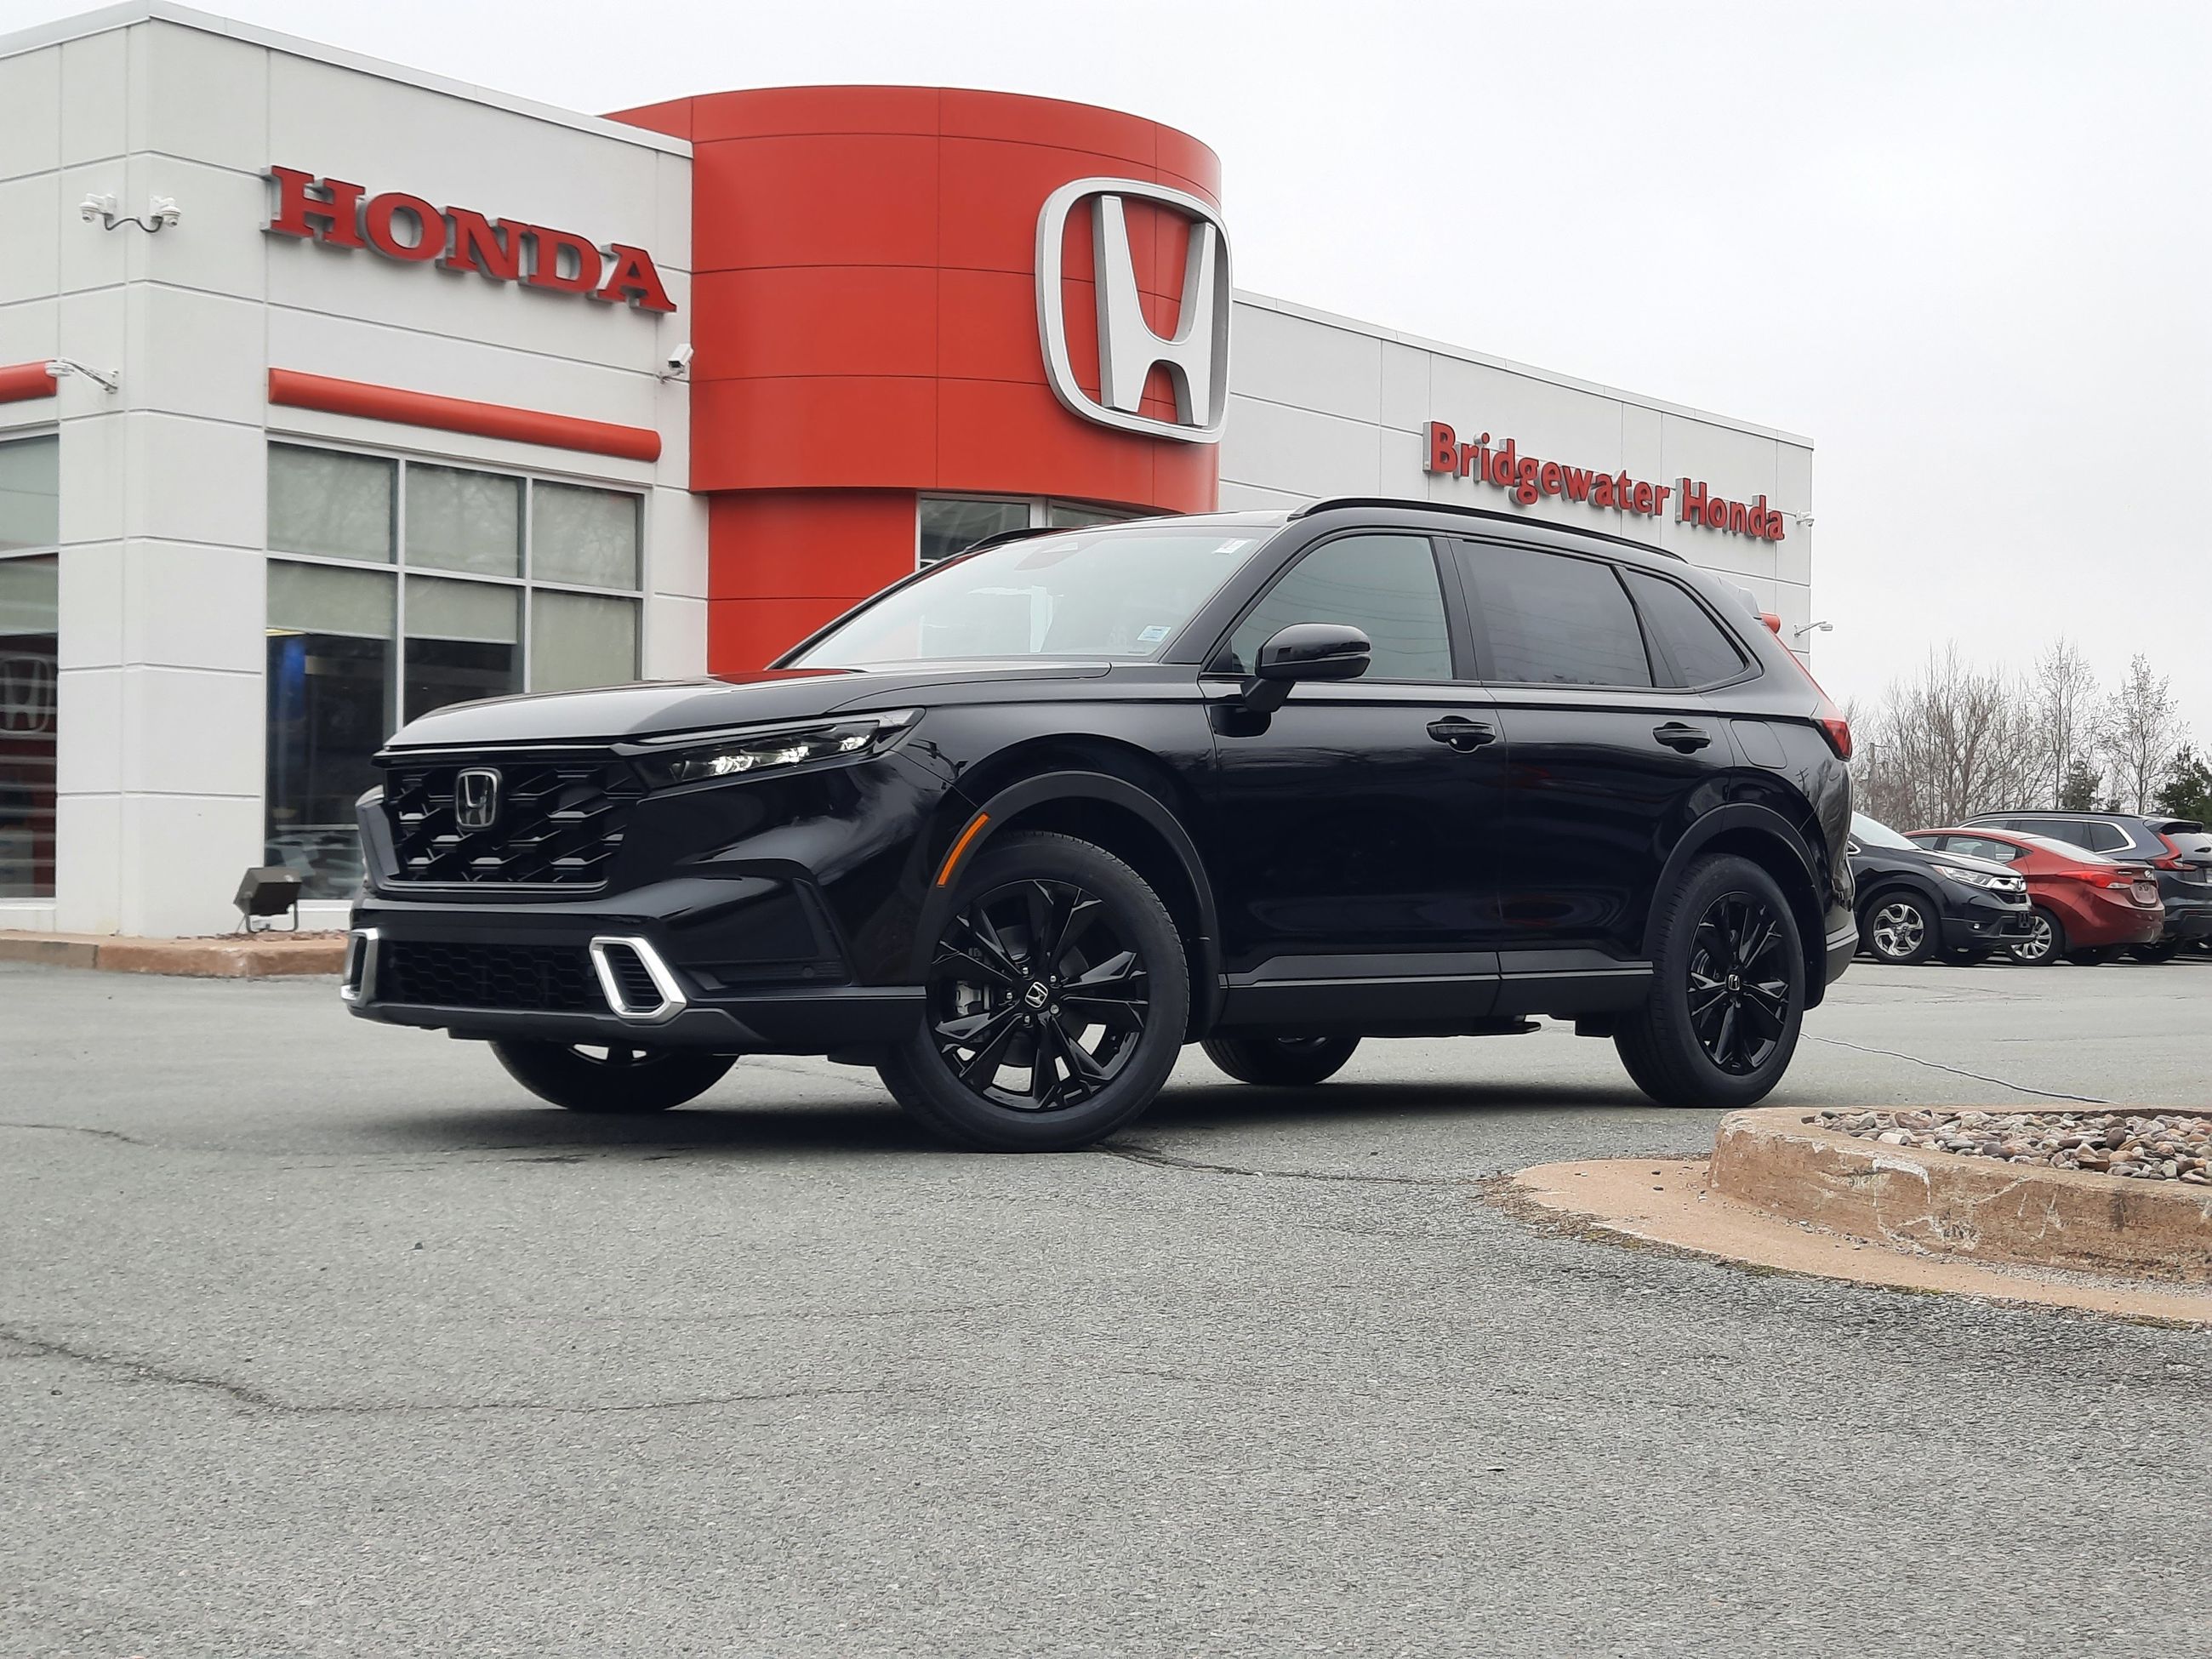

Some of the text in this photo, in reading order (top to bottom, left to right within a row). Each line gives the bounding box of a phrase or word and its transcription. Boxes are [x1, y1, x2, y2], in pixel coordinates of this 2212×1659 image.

[270, 165, 677, 313] HONDA
[1429, 420, 1786, 542] Bridgewater Honda
